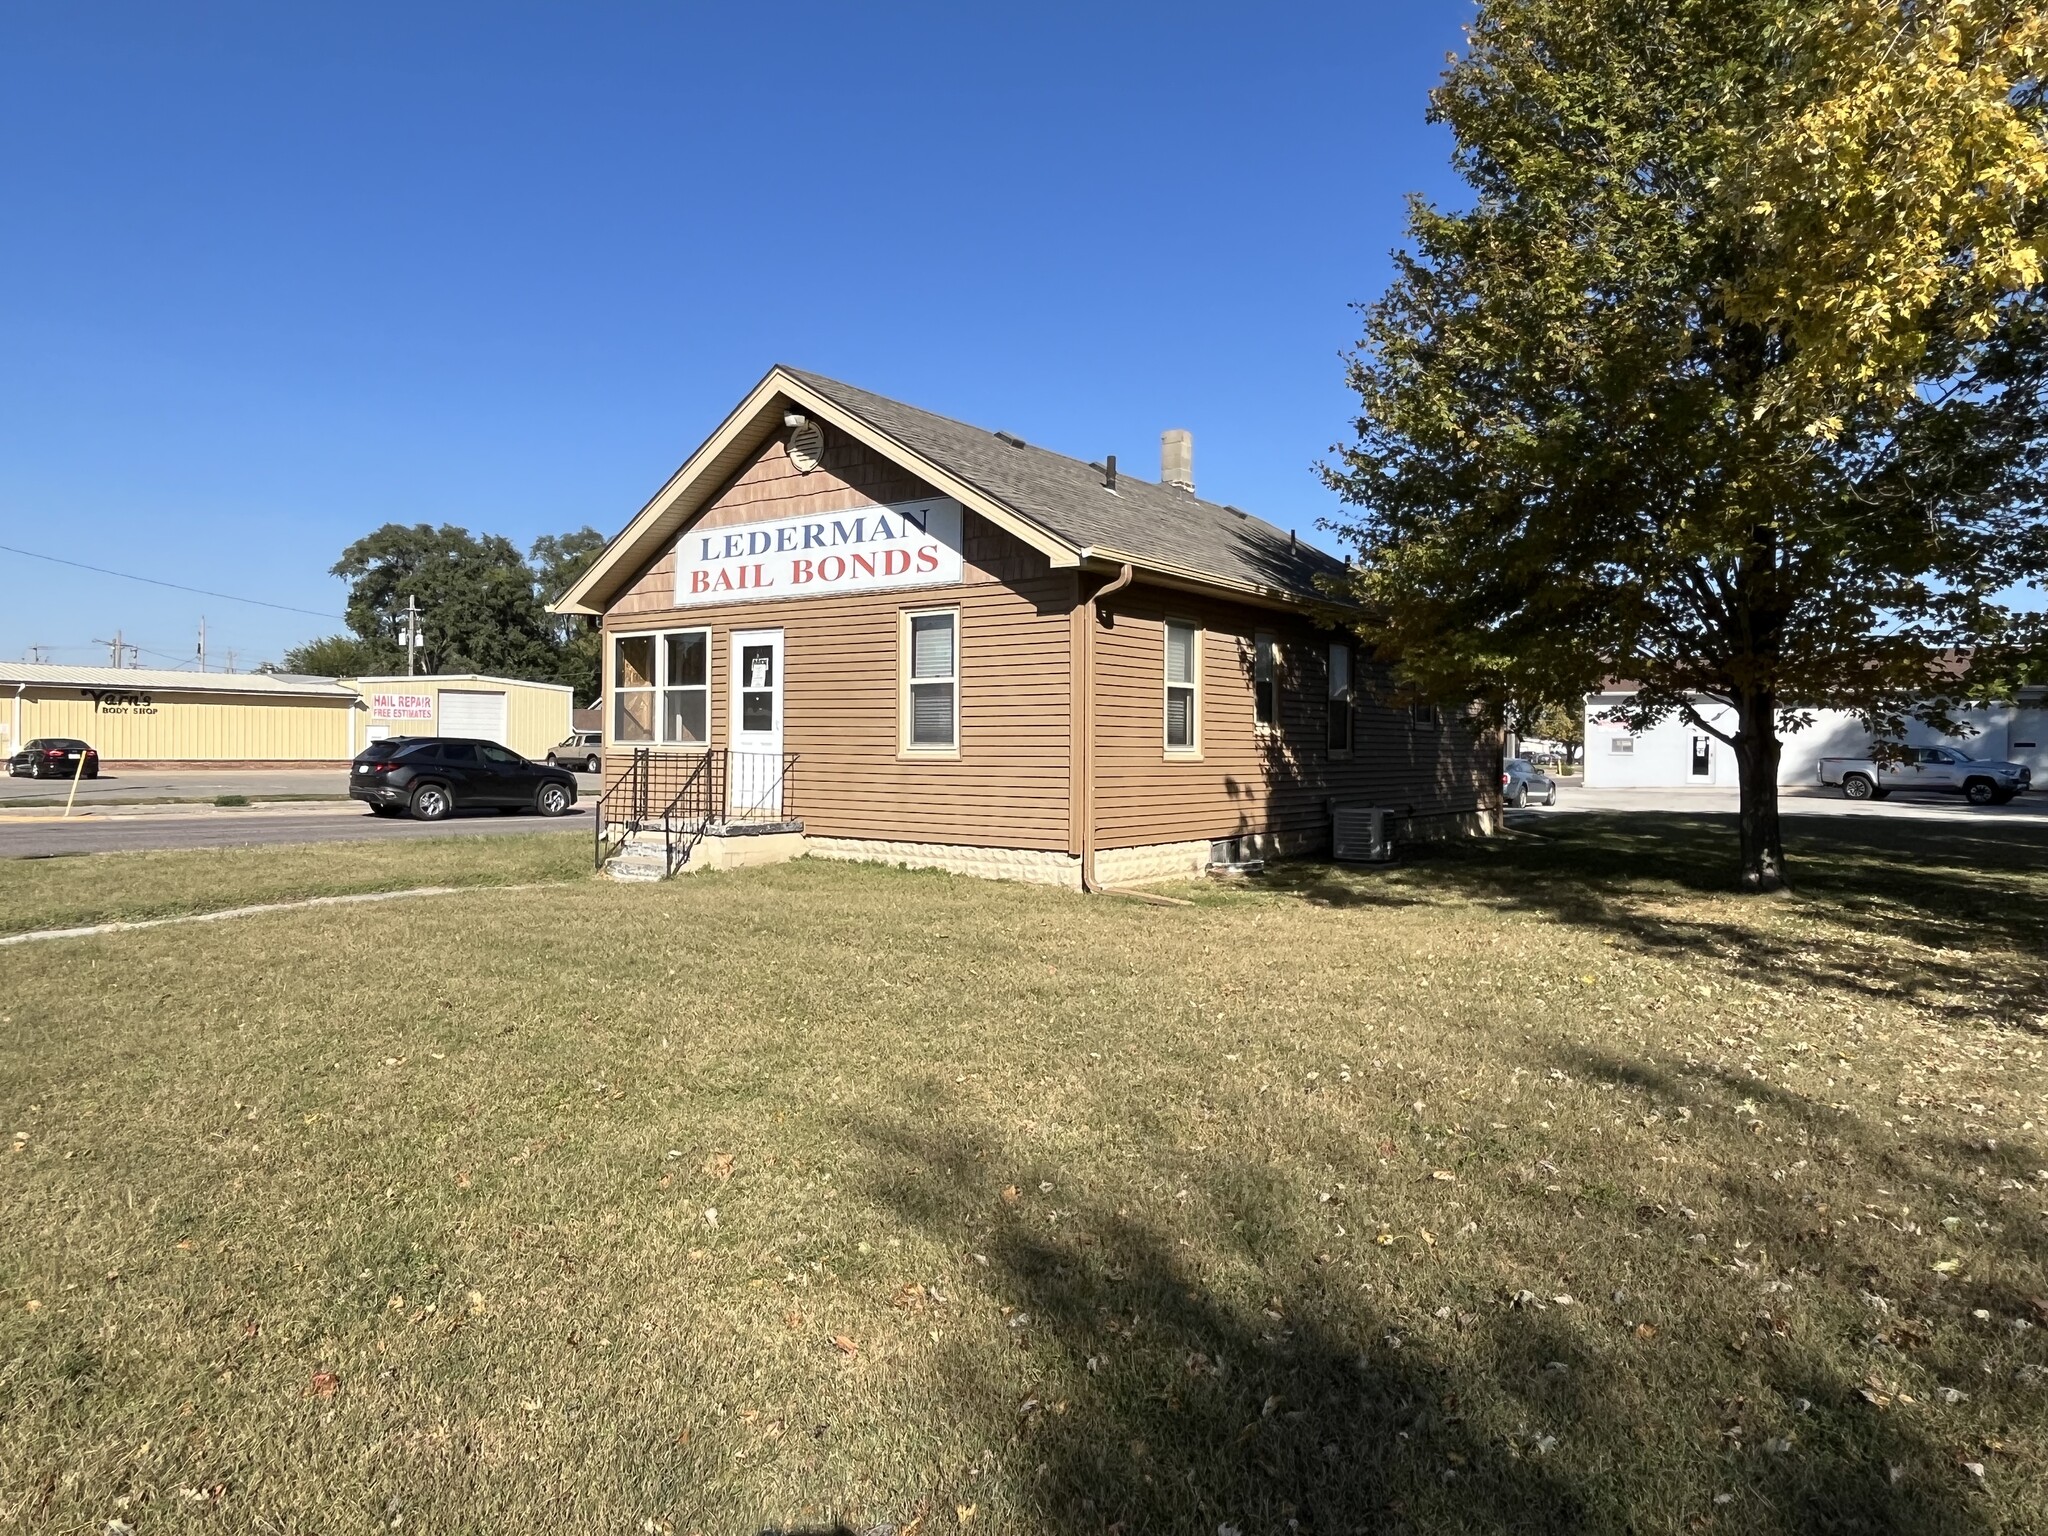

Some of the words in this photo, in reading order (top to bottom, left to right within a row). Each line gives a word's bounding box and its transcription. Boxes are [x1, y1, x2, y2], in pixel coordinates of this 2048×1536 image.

[700, 508, 931, 562] LEDERMAN
[690, 563, 774, 594] BAIL
[791, 544, 939, 585] BONDS
[374, 695, 396, 707] HAIL
[398, 696, 431, 708] REPAIR
[133, 707, 158, 715] SHOP
[373, 708, 391, 718] FREE
[393, 708, 432, 718] ESTIMATES
